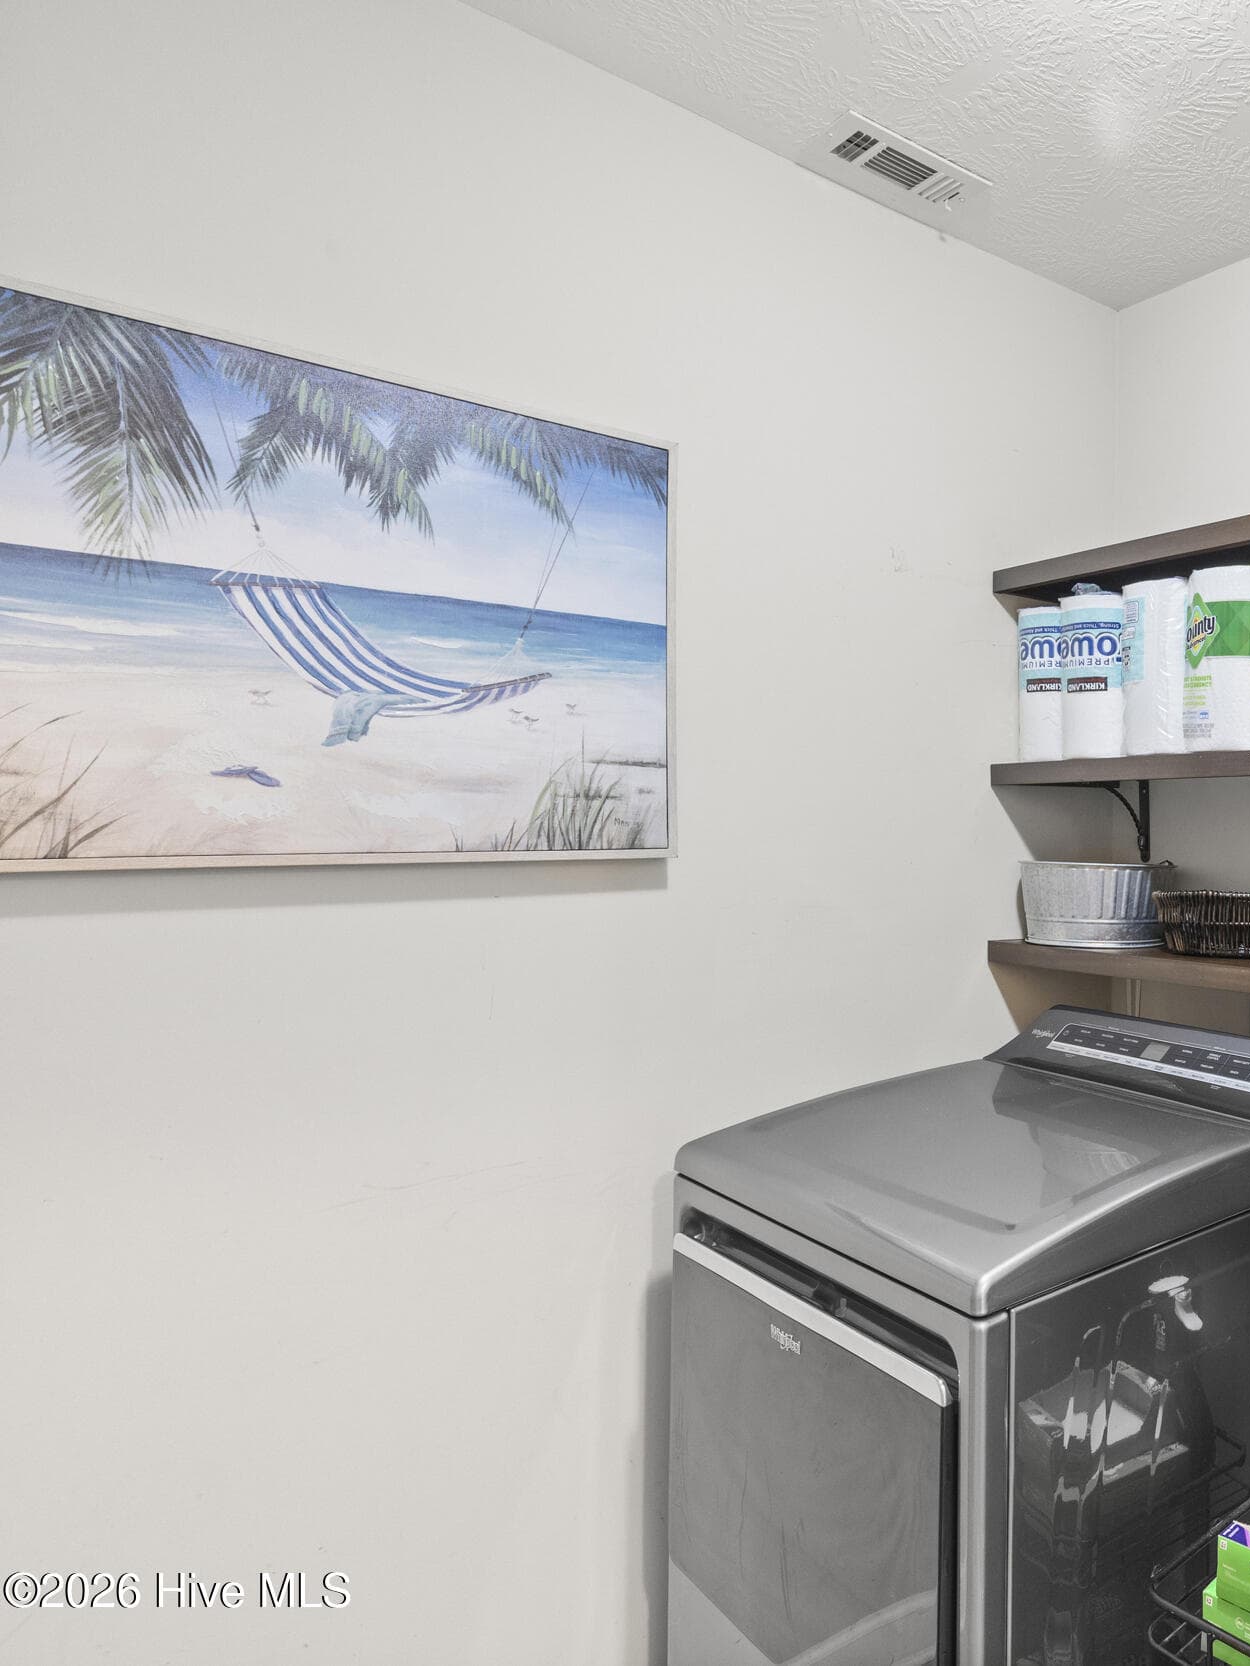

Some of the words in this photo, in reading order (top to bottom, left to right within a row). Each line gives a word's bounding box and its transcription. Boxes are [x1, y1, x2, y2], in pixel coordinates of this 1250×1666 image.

[1187, 616, 1215, 642] ounty
[1023, 660, 1062, 669] REMIUM
[1068, 682, 1105, 691] KIRKLAND
